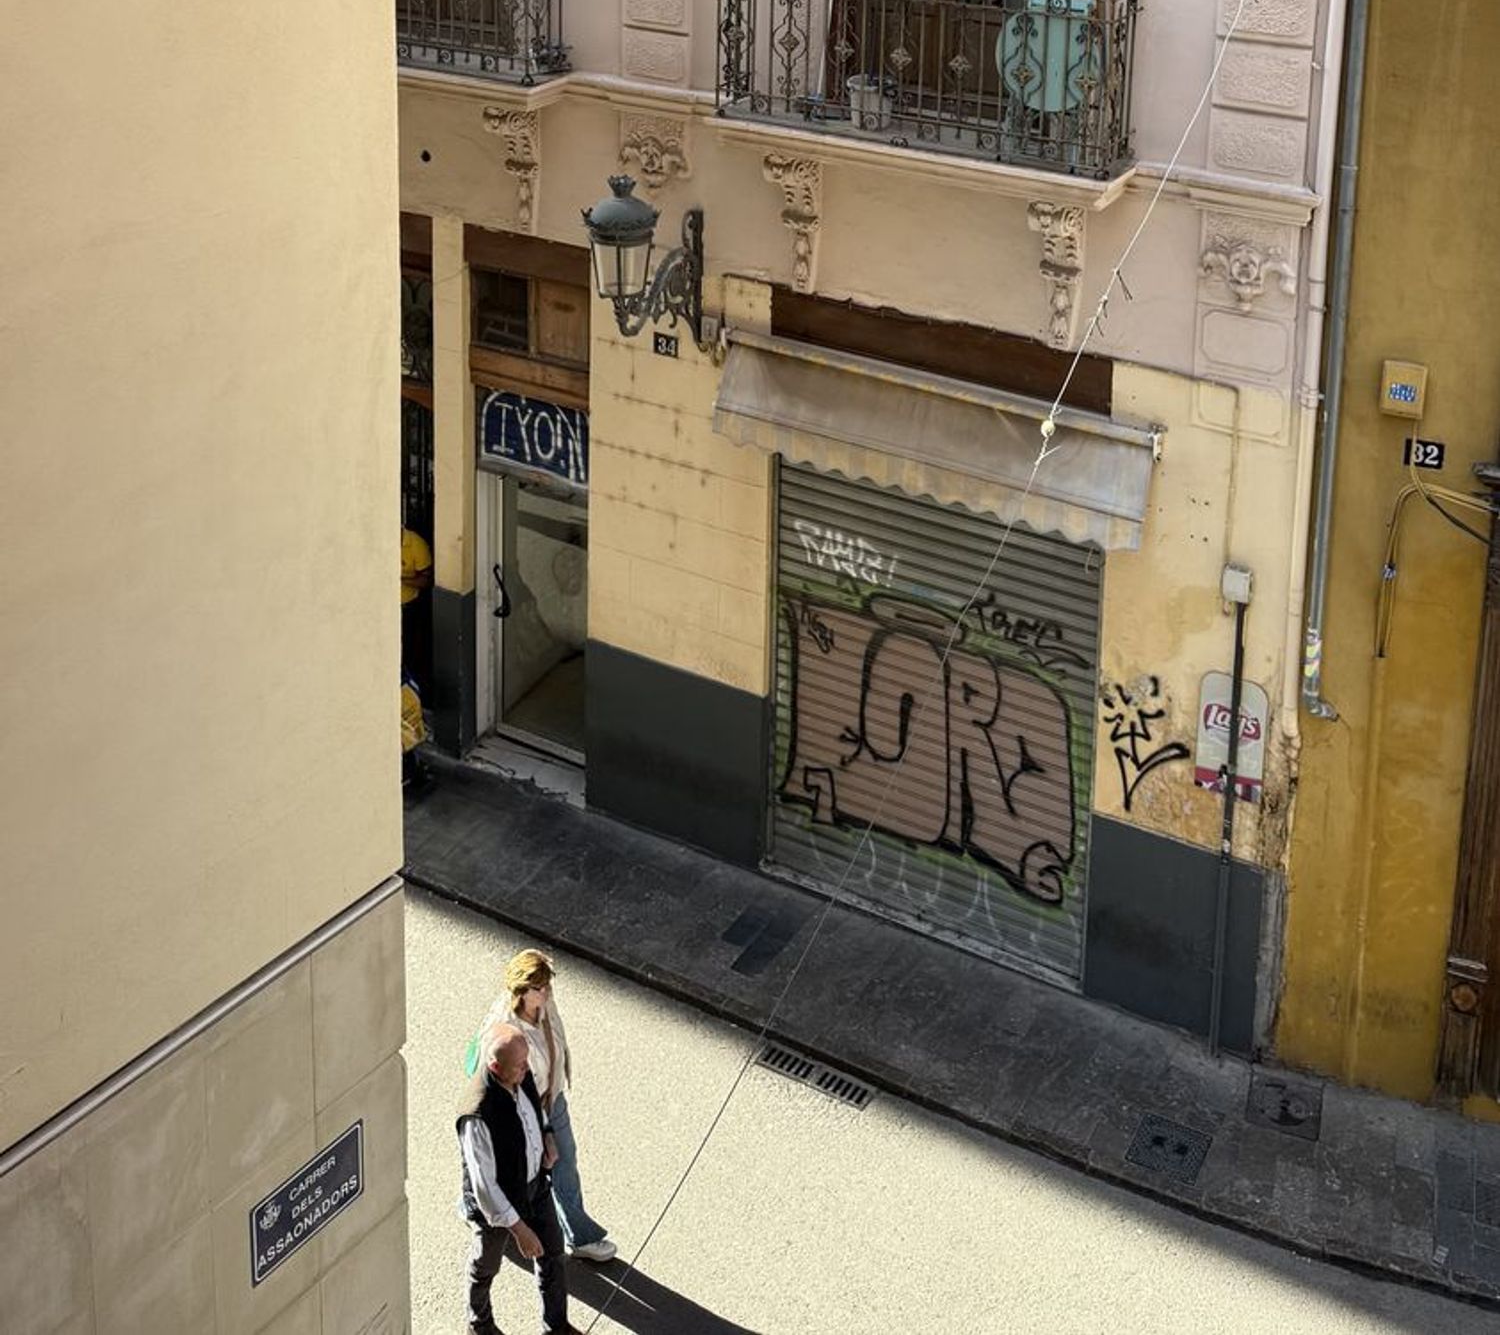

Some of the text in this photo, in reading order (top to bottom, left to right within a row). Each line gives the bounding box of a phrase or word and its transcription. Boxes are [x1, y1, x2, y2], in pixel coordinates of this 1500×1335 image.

[657, 337, 677, 356] 34
[1413, 443, 1440, 466] 32
[288, 1155, 337, 1201] CARRER
[291, 1185, 324, 1219] DELS
[257, 1174, 358, 1270] ASSAONADORS
